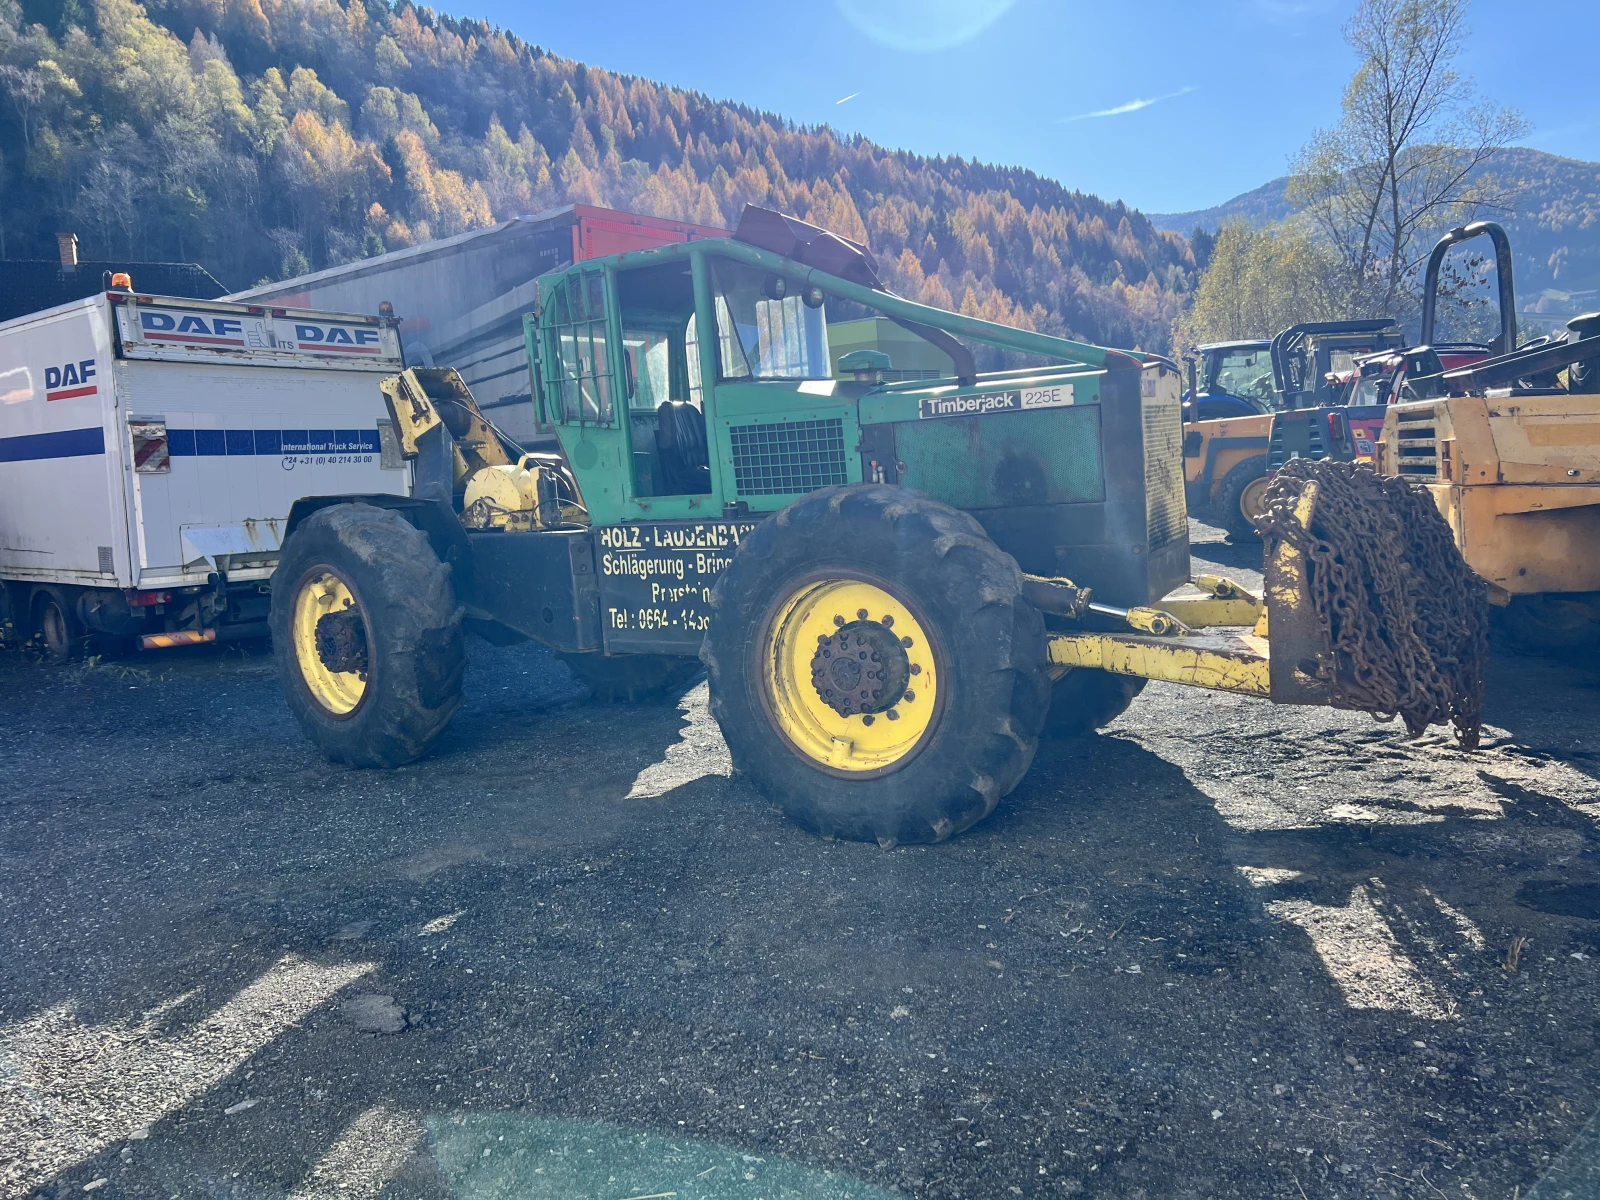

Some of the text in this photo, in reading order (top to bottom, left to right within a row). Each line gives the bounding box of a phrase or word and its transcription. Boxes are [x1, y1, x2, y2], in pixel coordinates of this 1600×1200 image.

[140, 311, 243, 336] DAF
[295, 324, 379, 345] DAF
[277, 340, 294, 350] ITS
[44, 358, 96, 389] DAF
[927, 388, 1062, 414] Timberjack 225E
[281, 442, 373, 451] International Truck Service
[299, 457, 313, 465] +31
[315, 456, 326, 465] (0)
[328, 456, 337, 464] 40
[338, 456, 351, 464] 214
[353, 455, 362, 463] 30
[363, 455, 373, 463] 00
[600, 526, 642, 548] HOLZ
[602, 553, 684, 580] Schlägerung
